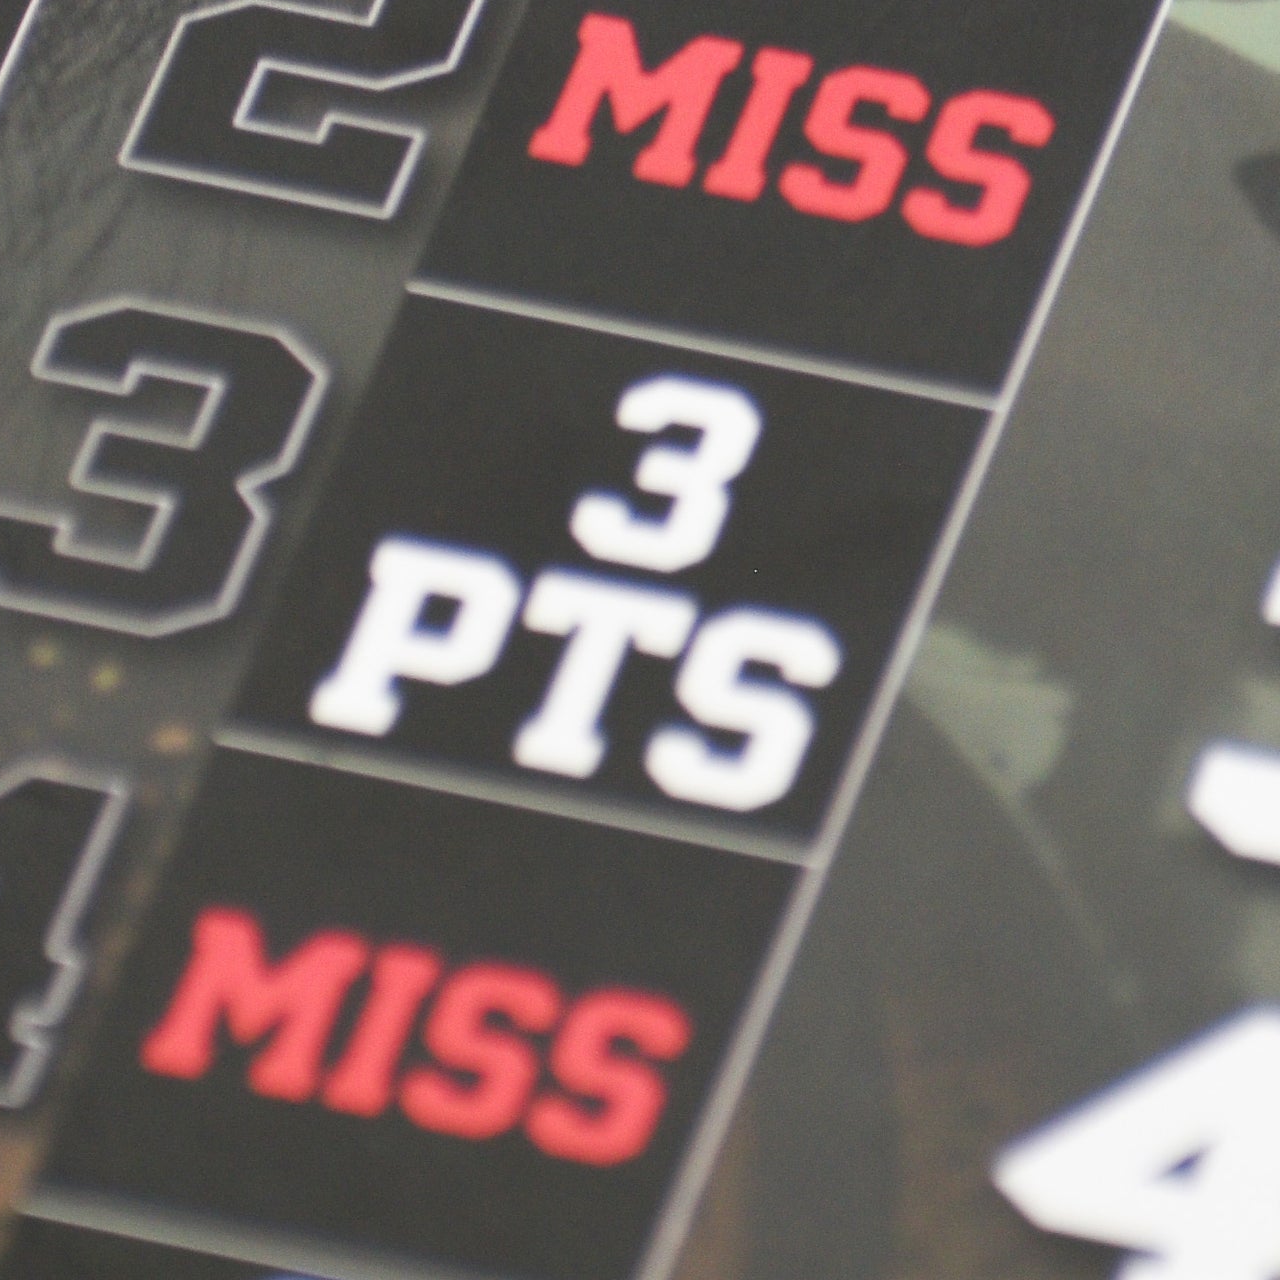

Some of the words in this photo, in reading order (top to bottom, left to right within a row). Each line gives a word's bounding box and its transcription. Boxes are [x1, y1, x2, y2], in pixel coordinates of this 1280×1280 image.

[528, 12, 1056, 247] MISS
[572, 379, 759, 571] 3
[308, 537, 842, 813] PTS
[142, 907, 690, 1165] MISS
